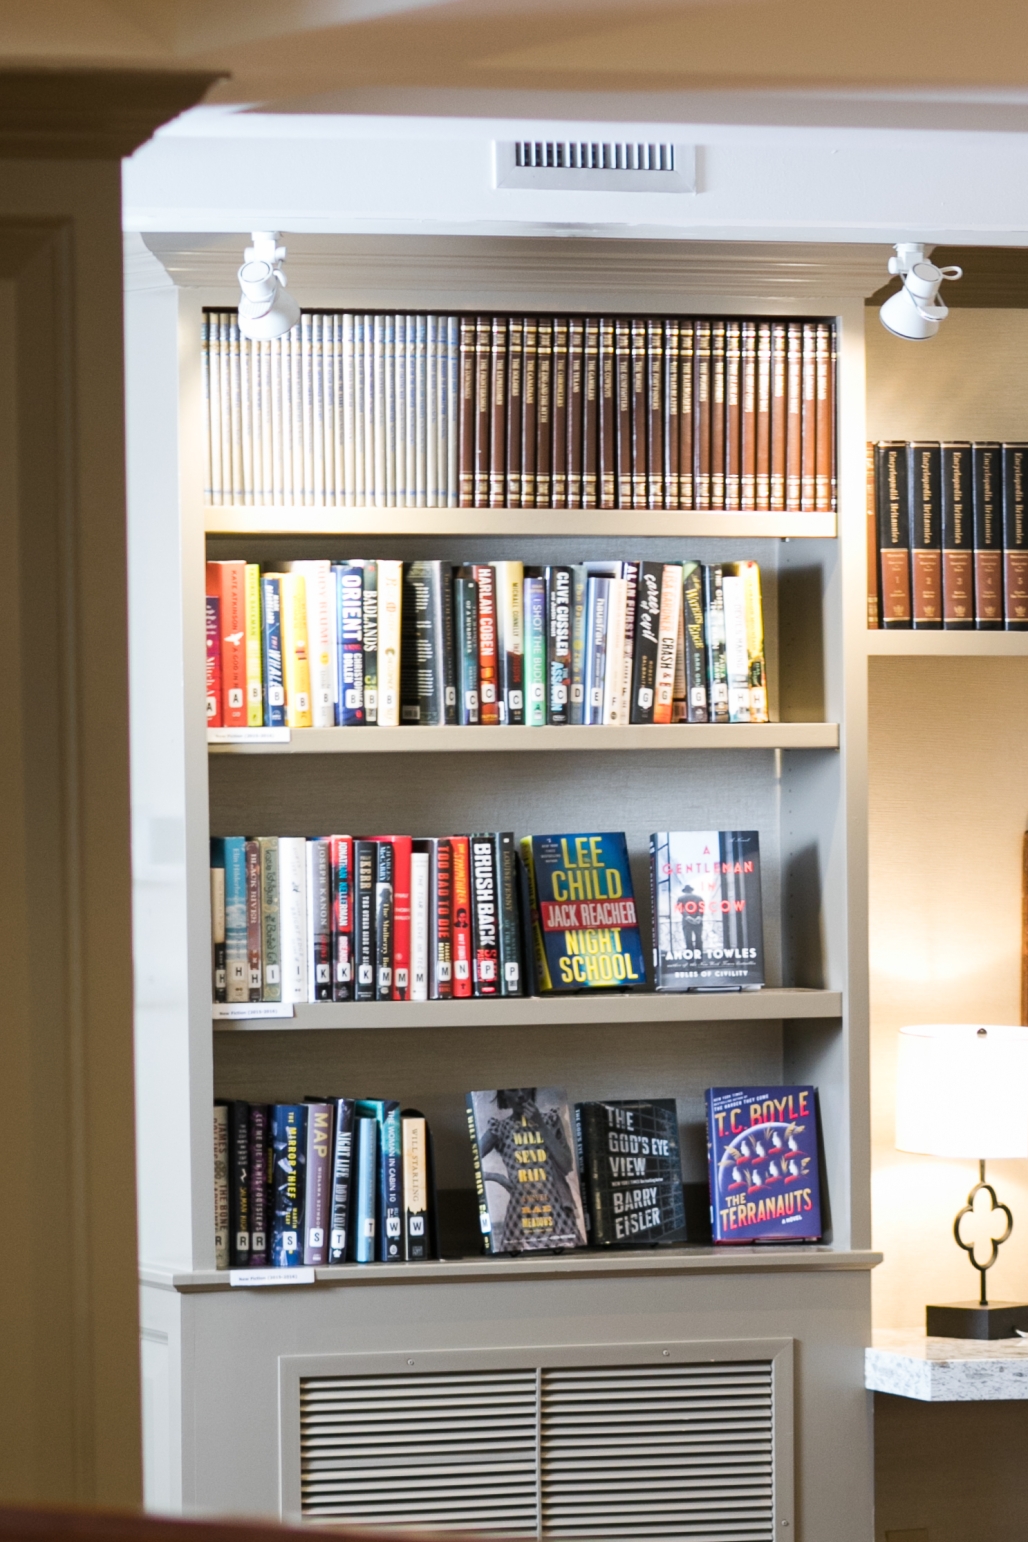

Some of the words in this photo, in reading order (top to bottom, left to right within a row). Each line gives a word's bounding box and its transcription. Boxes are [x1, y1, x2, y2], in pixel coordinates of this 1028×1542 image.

[923, 504, 933, 543] Britannica
[479, 569, 492, 614] HARLAN
[557, 572, 569, 602] CLIVE
[626, 565, 637, 597] ALAN
[640, 601, 647, 609] of
[644, 574, 659, 615] career
[342, 574, 362, 641] ORIENT
[533, 604, 542, 631] SHOT
[363, 591, 377, 651] BADLANDS
[556, 604, 569, 656] CUSSLER
[595, 598, 604, 645] hausfrau
[640, 613, 658, 643] evil
[480, 618, 493, 656] COBEN
[534, 636, 542, 654] THE
[661, 638, 674, 669] CRASH
[233, 694, 239, 703] A
[351, 695, 356, 703] B
[558, 690, 563, 699] C
[643, 693, 648, 702] G
[338, 841, 347, 879] JONATHAN
[437, 846, 449, 868] TOO
[561, 836, 605, 868] LEE
[703, 846, 711, 855] A
[315, 845, 326, 883] JOSEPH
[360, 861, 372, 889] KERR
[473, 843, 493, 901] BRUSH
[503, 851, 511, 881] LOUISE
[662, 861, 754, 875] GENTLEMAN
[437, 873, 449, 896] BAD
[453, 854, 467, 904] SYMPATHIZER
[551, 869, 622, 901] CHILD
[701, 881, 716, 891] IN
[317, 888, 327, 925] KANON
[339, 882, 347, 926] KELLERMAN
[438, 901, 449, 914] TO
[504, 883, 512, 911] PENNY
[674, 900, 746, 914] MOSCOW
[477, 903, 495, 946] BACK
[547, 905, 579, 928] JACK
[580, 901, 637, 926] REACHER
[381, 920, 389, 955] Mulberry
[438, 919, 450, 938] DIE
[362, 947, 369, 955] OF
[565, 928, 622, 955] NIGHT
[665, 949, 702, 960] AMOR
[707, 948, 757, 960] TOWLES
[236, 967, 242, 976] H
[363, 970, 368, 979] K
[459, 965, 465, 973] N
[510, 967, 515, 976] P
[559, 953, 638, 983] SCHOOL
[605, 1106, 634, 1131] THE
[715, 1108, 748, 1137] T.C.
[750, 1091, 809, 1128] BOYLE
[256, 1130, 262, 1140] ME
[288, 1127, 297, 1167] MIRROR
[313, 1112, 328, 1158] MAP
[338, 1132, 351, 1157] NIGHT
[513, 1131, 544, 1145] WILL
[609, 1132, 650, 1155] GOD'S
[652, 1138, 669, 1156] EYE
[256, 1160, 262, 1168] IN
[336, 1159, 349, 1177] LIFE
[389, 1158, 395, 1167] IN
[515, 1149, 547, 1163] SEND
[609, 1157, 646, 1177] VIEW
[287, 1171, 296, 1199] THIEF
[518, 1168, 547, 1182] RAIN
[389, 1193, 396, 1202] 10
[613, 1187, 657, 1214] BARRY
[720, 1188, 813, 1232] TERRANAUTS
[725, 1193, 746, 1208] THE
[414, 1222, 421, 1231] W
[615, 1207, 660, 1239] EISLER
[786, 1215, 802, 1224] NOVEL
[240, 1237, 247, 1246] R
[287, 1236, 293, 1245] S
